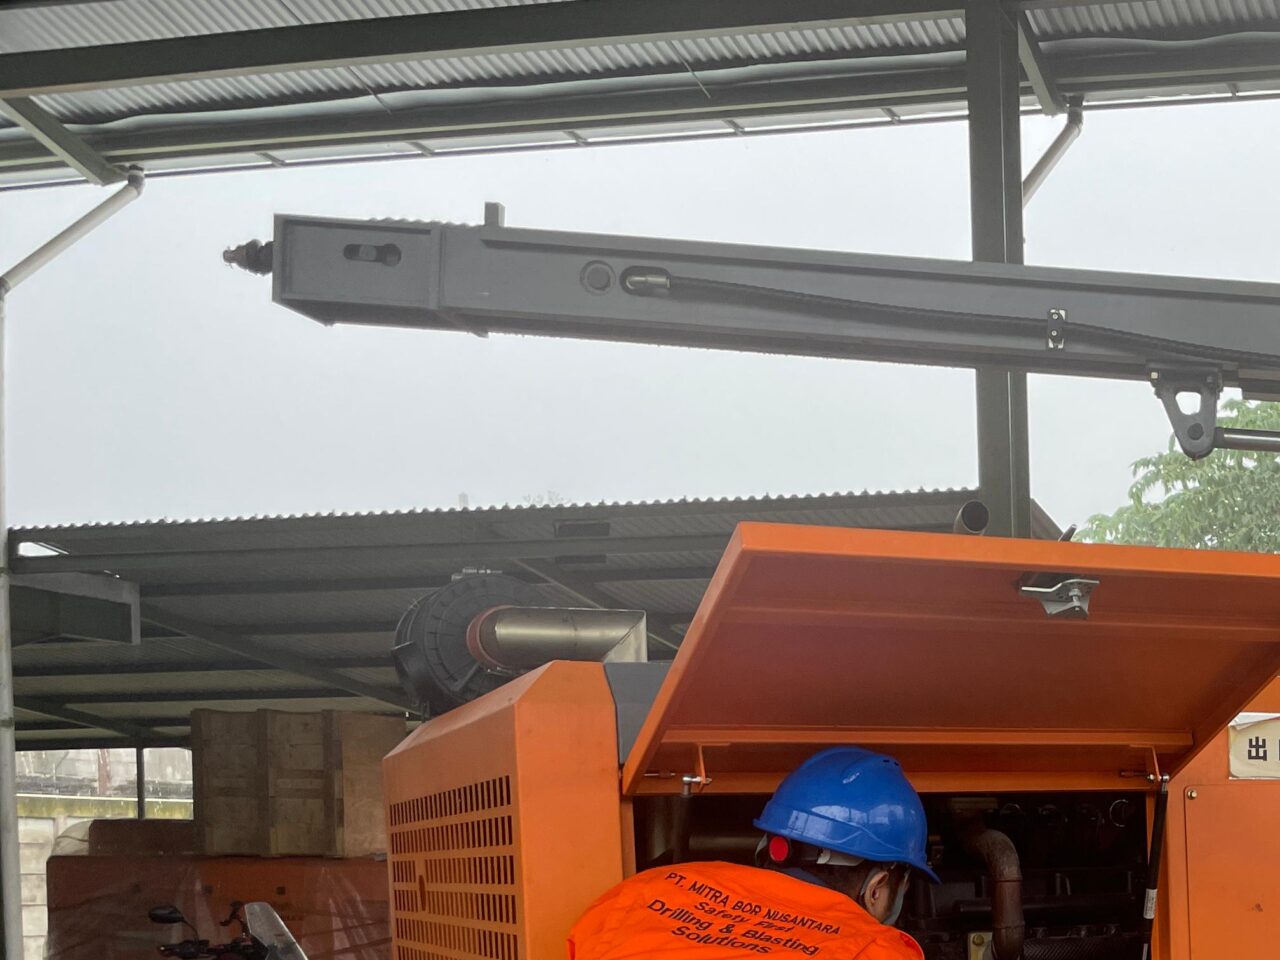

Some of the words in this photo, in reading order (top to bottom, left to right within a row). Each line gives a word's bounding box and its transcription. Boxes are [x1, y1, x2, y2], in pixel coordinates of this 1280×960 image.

[665, 872, 687, 888] PT.
[688, 881, 730, 907] MITRA
[732, 900, 762, 916] BOR
[763, 908, 841, 935] NUSANTARA
[694, 901, 752, 923] Safety
[647, 899, 714, 931] Drilling
[718, 923, 736, 934] &
[741, 929, 820, 956] Blasting
[671, 926, 772, 954] Solutions
